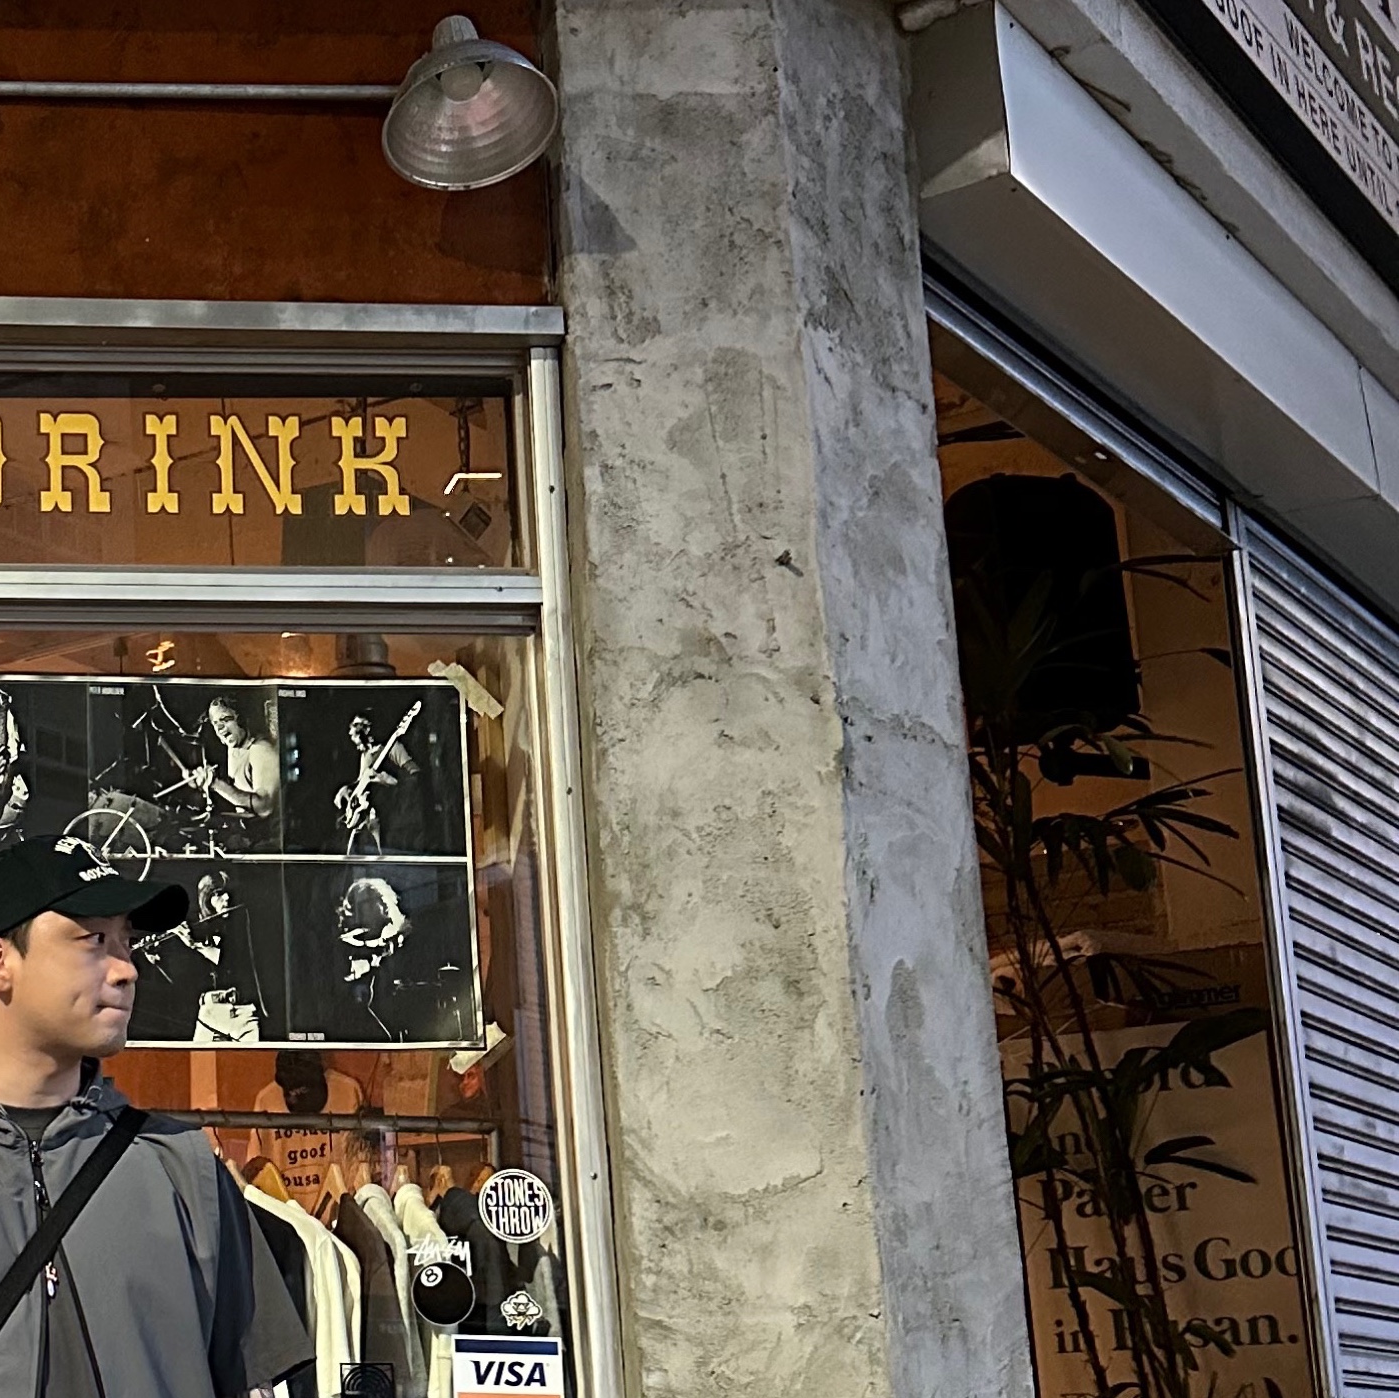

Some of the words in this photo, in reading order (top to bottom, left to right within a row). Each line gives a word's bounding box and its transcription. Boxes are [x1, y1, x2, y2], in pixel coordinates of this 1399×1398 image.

[1270, 43, 1290, 94] IN
[1294, 74, 1341, 156] HERE
[1372, 125, 1393, 171] TO
[288, 1143, 327, 1165] goof
[487, 1179, 545, 1207] STONES
[1040, 1177, 1198, 1221] Paer
[489, 1206, 544, 1235] THROW
[424, 1267, 439, 1284] 8
[469, 1360, 548, 1388] VISA
